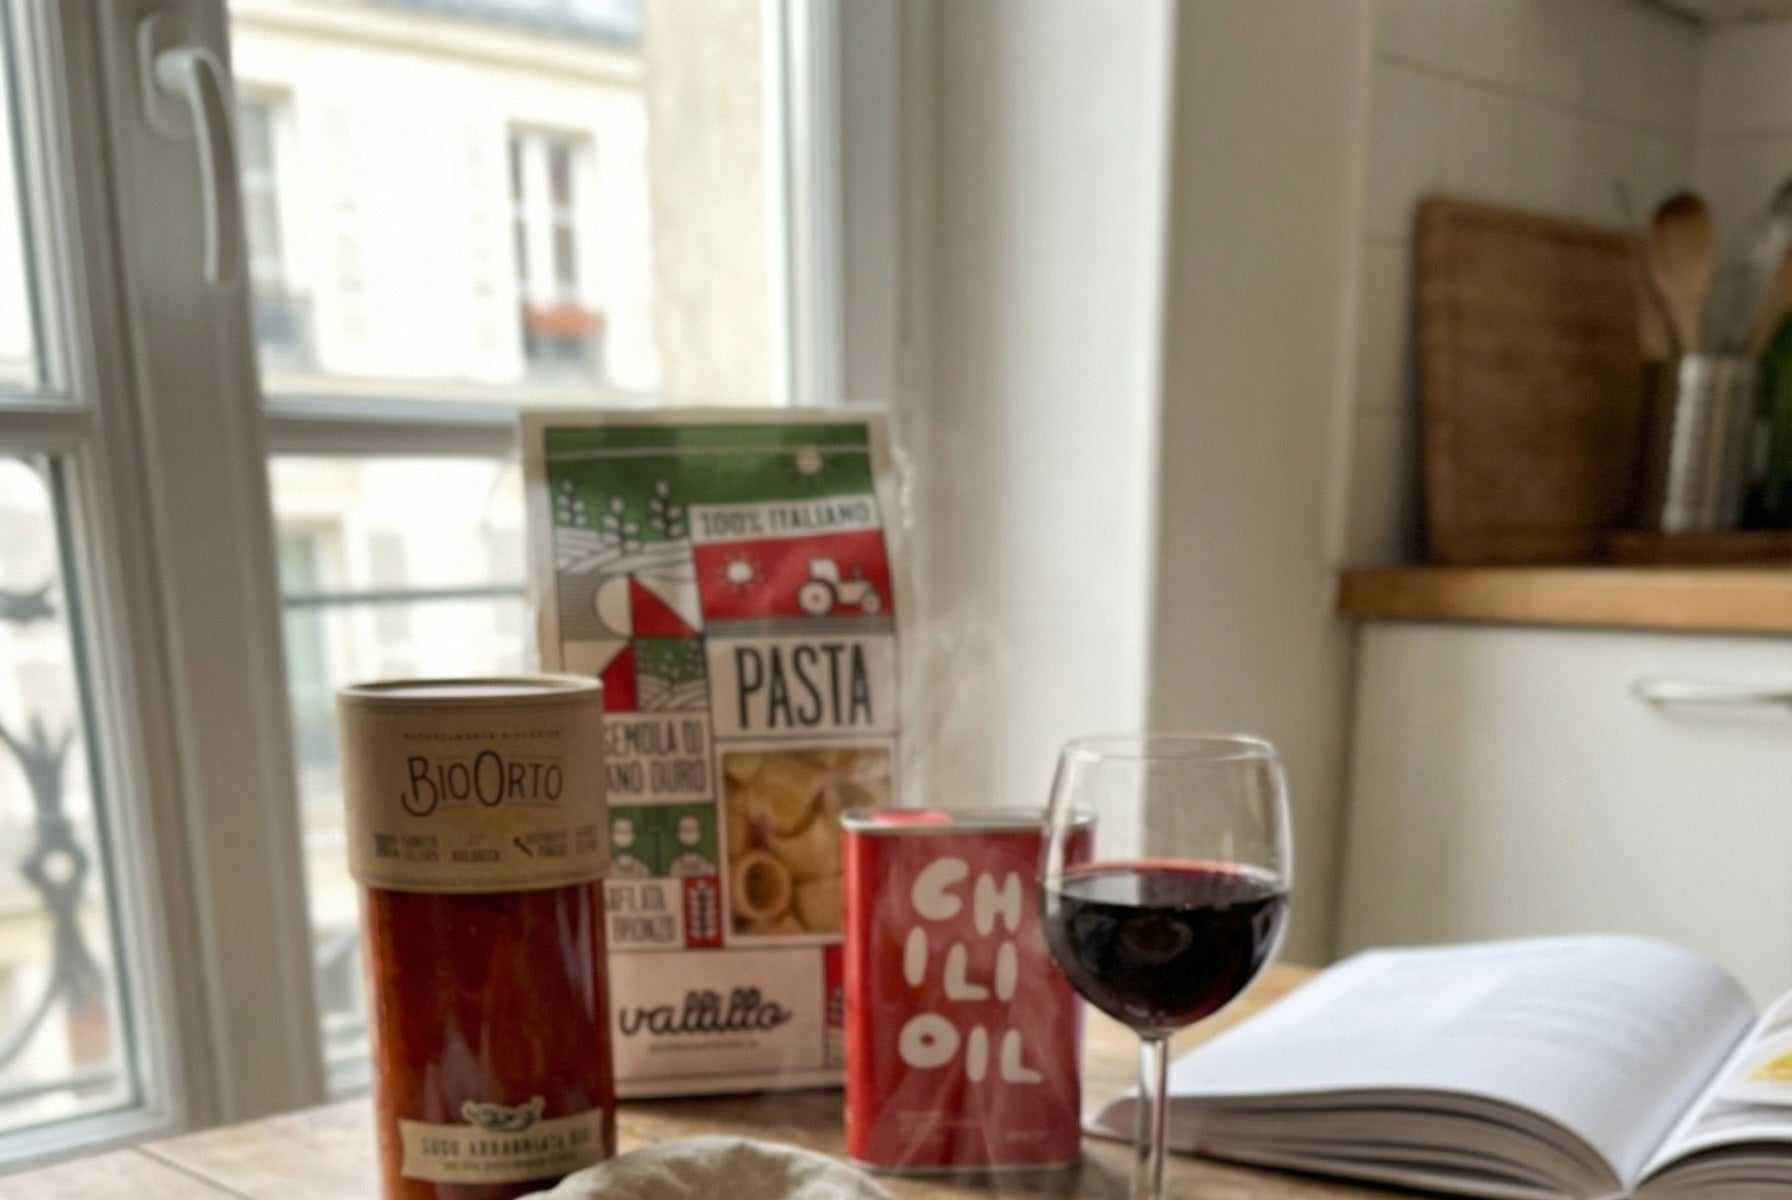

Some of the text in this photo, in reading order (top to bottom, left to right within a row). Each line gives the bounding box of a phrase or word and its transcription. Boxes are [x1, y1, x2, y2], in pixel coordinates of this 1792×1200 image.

[769, 501, 869, 531] ITALIANO
[735, 643, 873, 731] PASTA
[899, 1013, 1043, 1083] OIL
